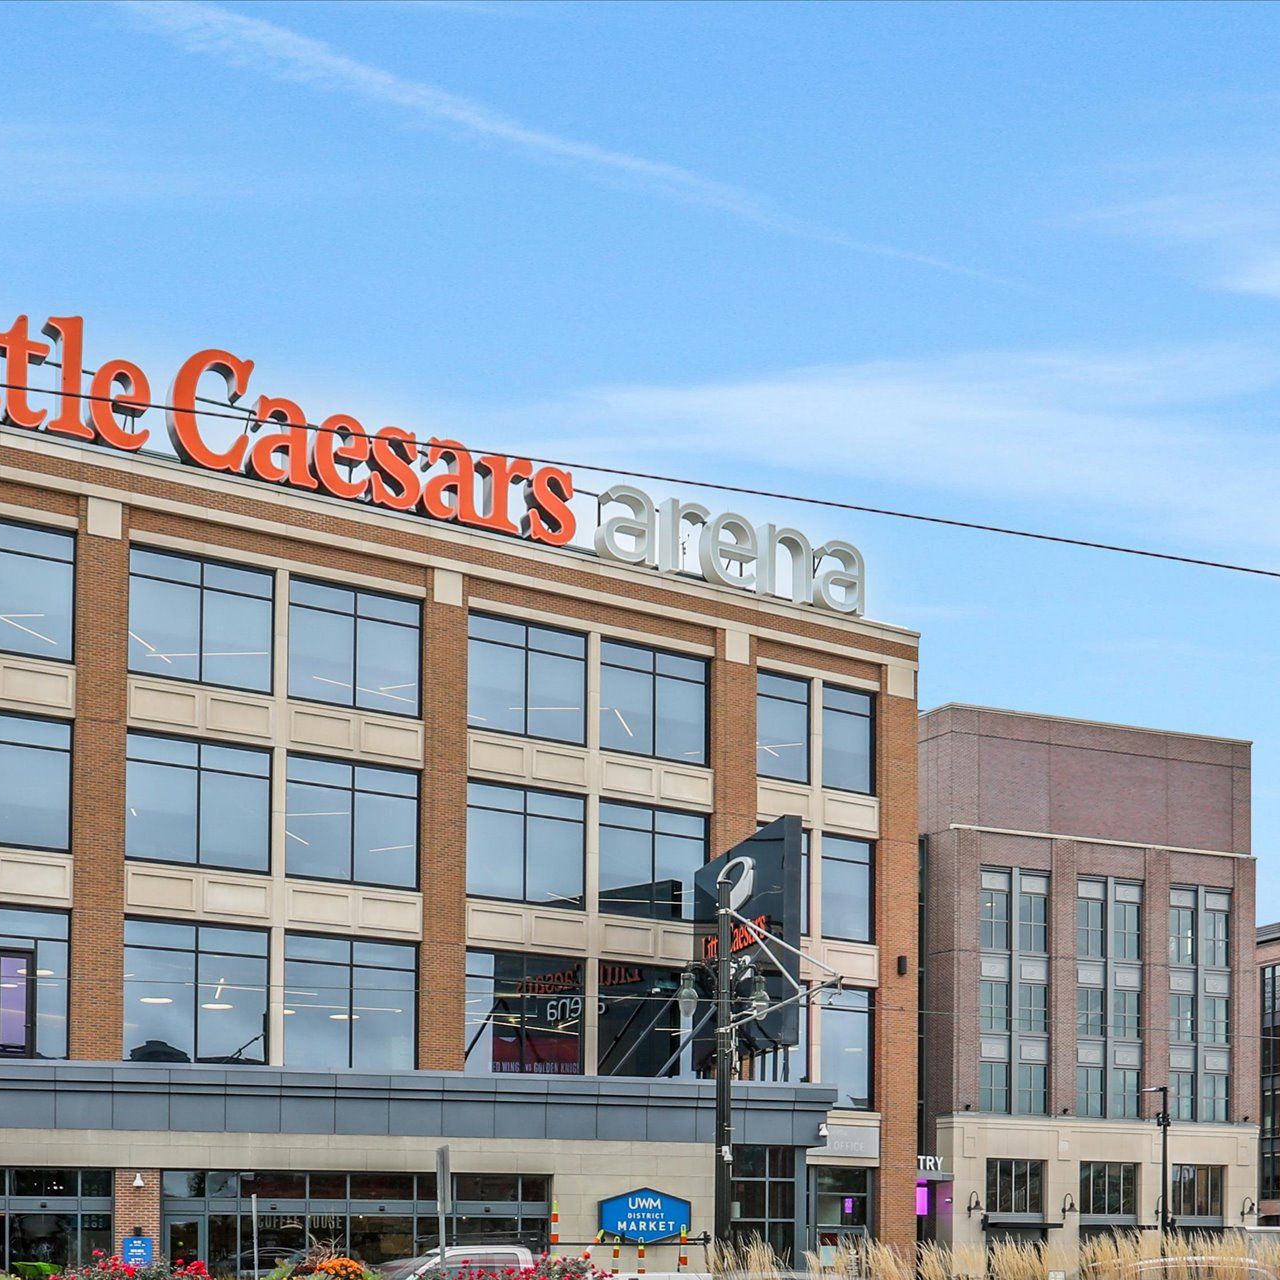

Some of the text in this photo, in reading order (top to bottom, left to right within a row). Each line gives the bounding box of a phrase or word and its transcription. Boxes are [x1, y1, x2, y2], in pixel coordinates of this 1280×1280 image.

[166, 348, 577, 547] Caesars
[593, 484, 865, 617] arena
[701, 936, 719, 965] Litt
[502, 1062, 520, 1073] WING
[560, 1062, 580, 1075] KNIG
[918, 1156, 944, 1171] TRY
[628, 1197, 662, 1210] UWM
[617, 1221, 675, 1231] MARKET
